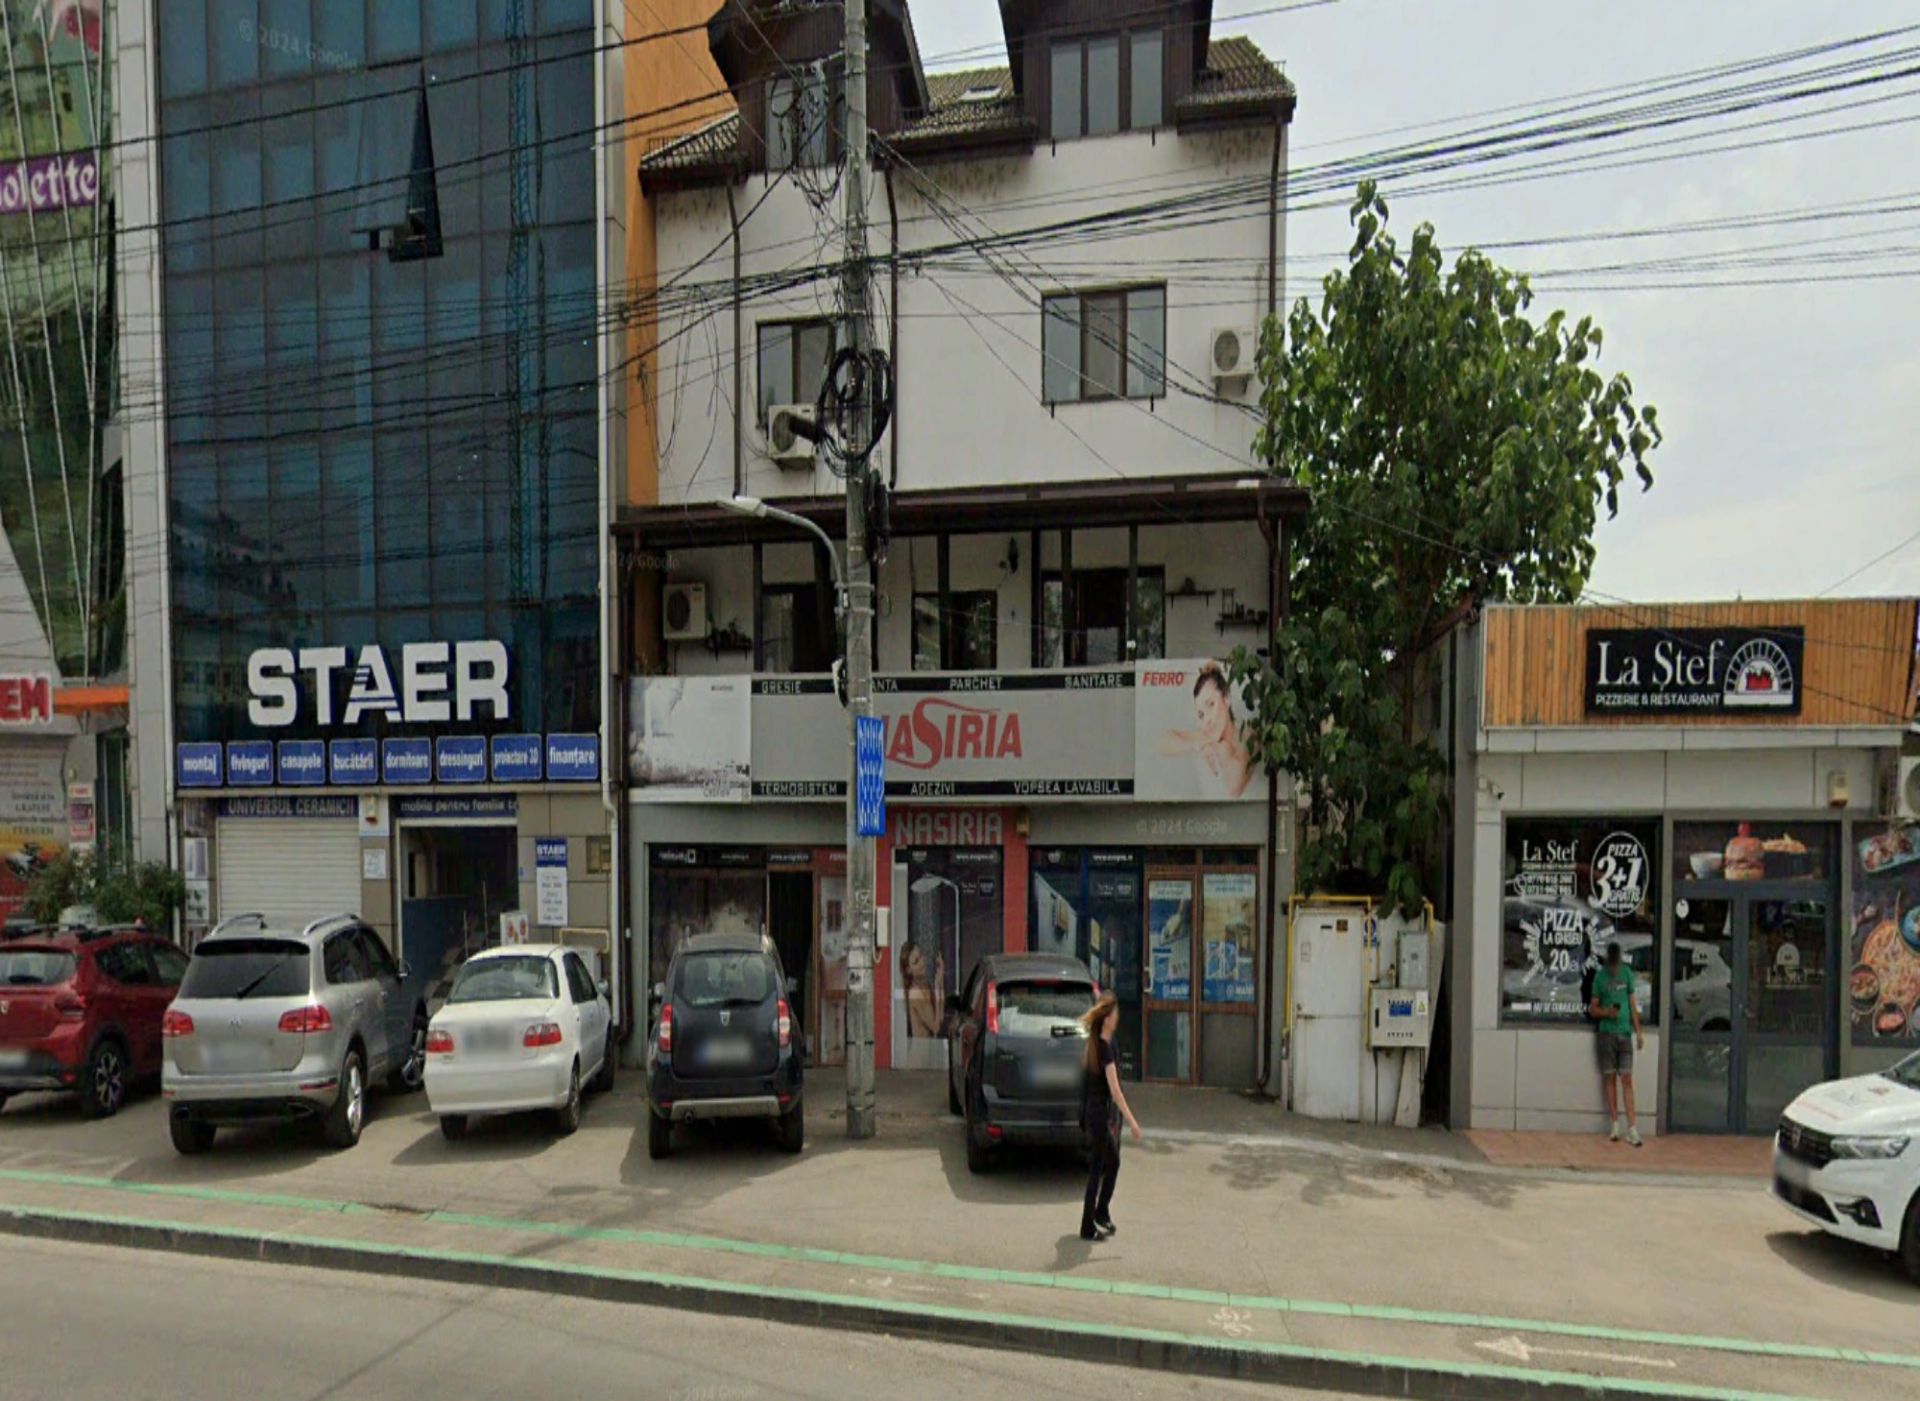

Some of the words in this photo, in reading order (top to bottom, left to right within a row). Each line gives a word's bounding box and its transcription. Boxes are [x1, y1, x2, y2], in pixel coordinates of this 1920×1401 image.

[0, 156, 98, 208] olette
[1597, 640, 1640, 685] La
[248, 640, 509, 726] STAER
[761, 680, 802, 694] GRESIE
[950, 676, 1003, 690] PARCHET
[1064, 673, 1124, 688] SANITARE
[1142, 672, 1185, 686] FERRO
[1596, 692, 1640, 706] PIZZERIE
[1650, 691, 1722, 706] RESTAURANT
[884, 697, 1022, 769] ASIRIA
[183, 754, 217, 775] montaj
[281, 752, 322, 772] canapele
[386, 750, 428, 769] dormitoare
[759, 782, 838, 796] TERMOSISTEM
[910, 781, 955, 795] ADEZIVI
[1014, 781, 1060, 795] VOPSEA
[1064, 780, 1121, 794] LAVABILA
[228, 797, 293, 815] UNIVERSUL
[295, 796, 354, 815] CERAMICII
[895, 811, 1003, 846] NASIRIA
[1522, 839, 1543, 862] La
[1607, 844, 1638, 857] PIZZA
[1544, 909, 1583, 931] PIZZA
[1550, 948, 1570, 971] 20
